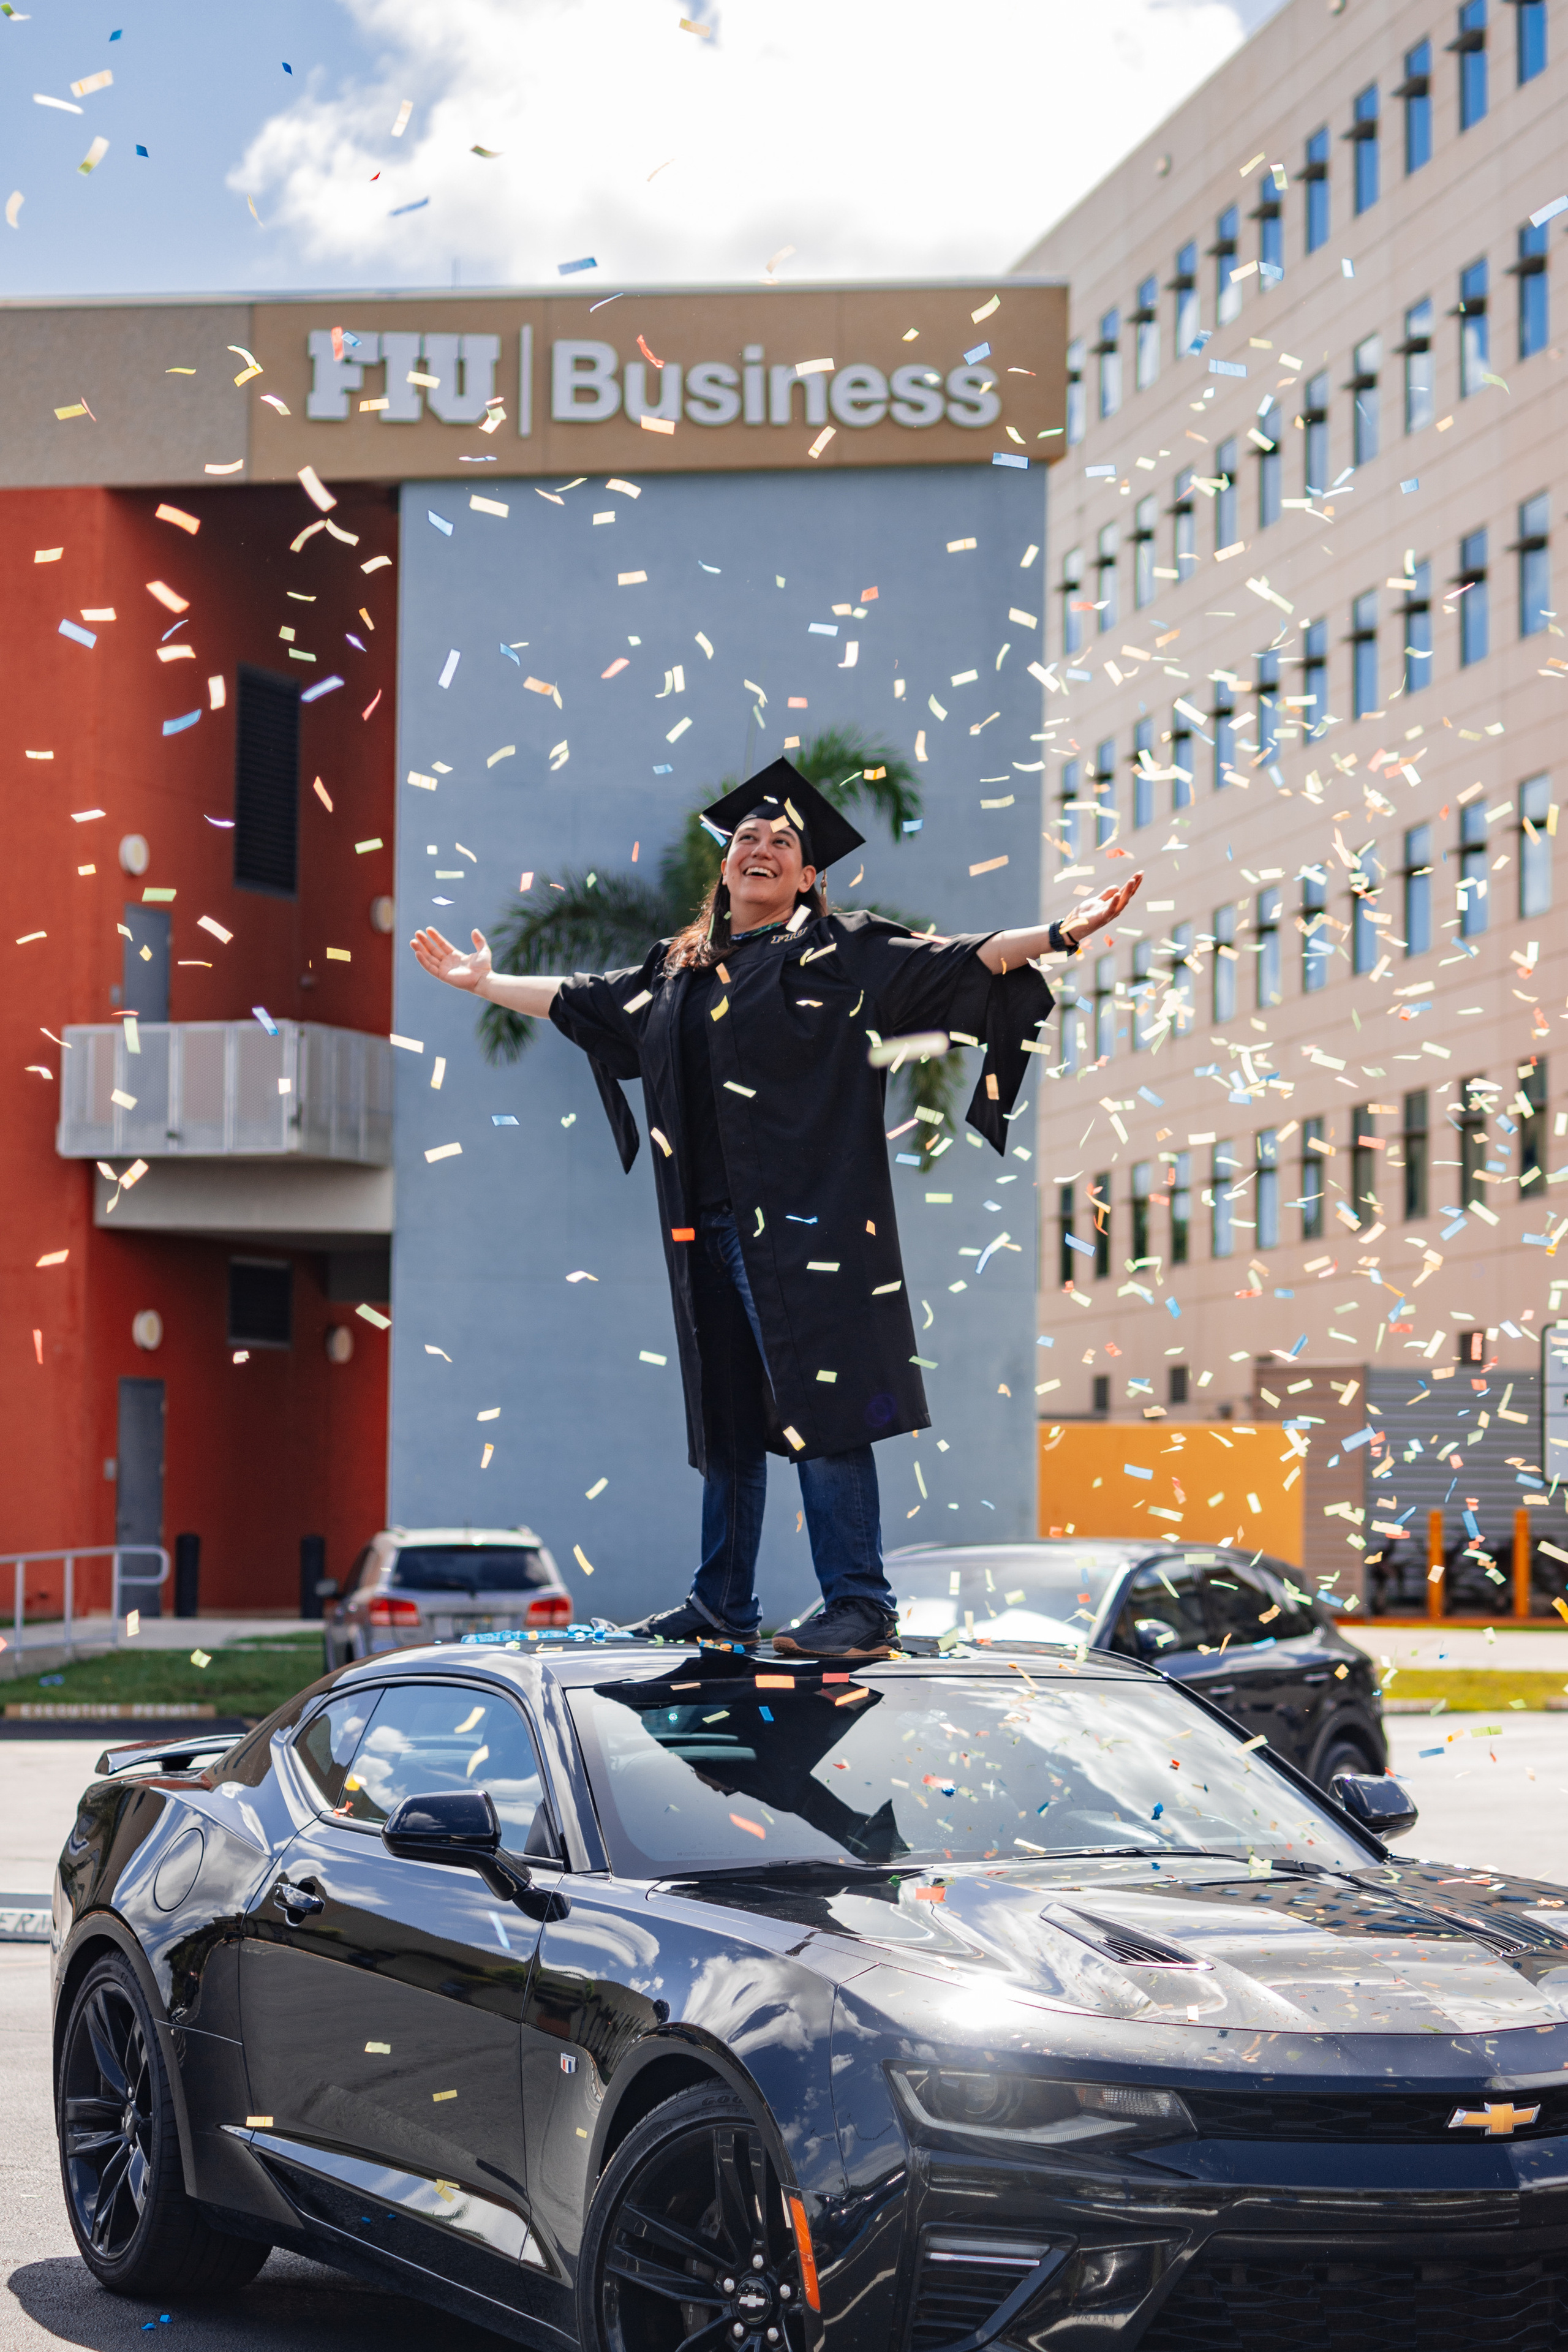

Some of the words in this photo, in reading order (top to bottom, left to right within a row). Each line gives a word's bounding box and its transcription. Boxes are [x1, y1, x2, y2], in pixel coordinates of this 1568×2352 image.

[307, 330, 500, 422] FIU
[552, 339, 1001, 427] Business
[771, 926, 808, 944] FIU
[20, 1703, 120, 1719] EXECUTIVE
[132, 1703, 198, 1719] PERMIT
